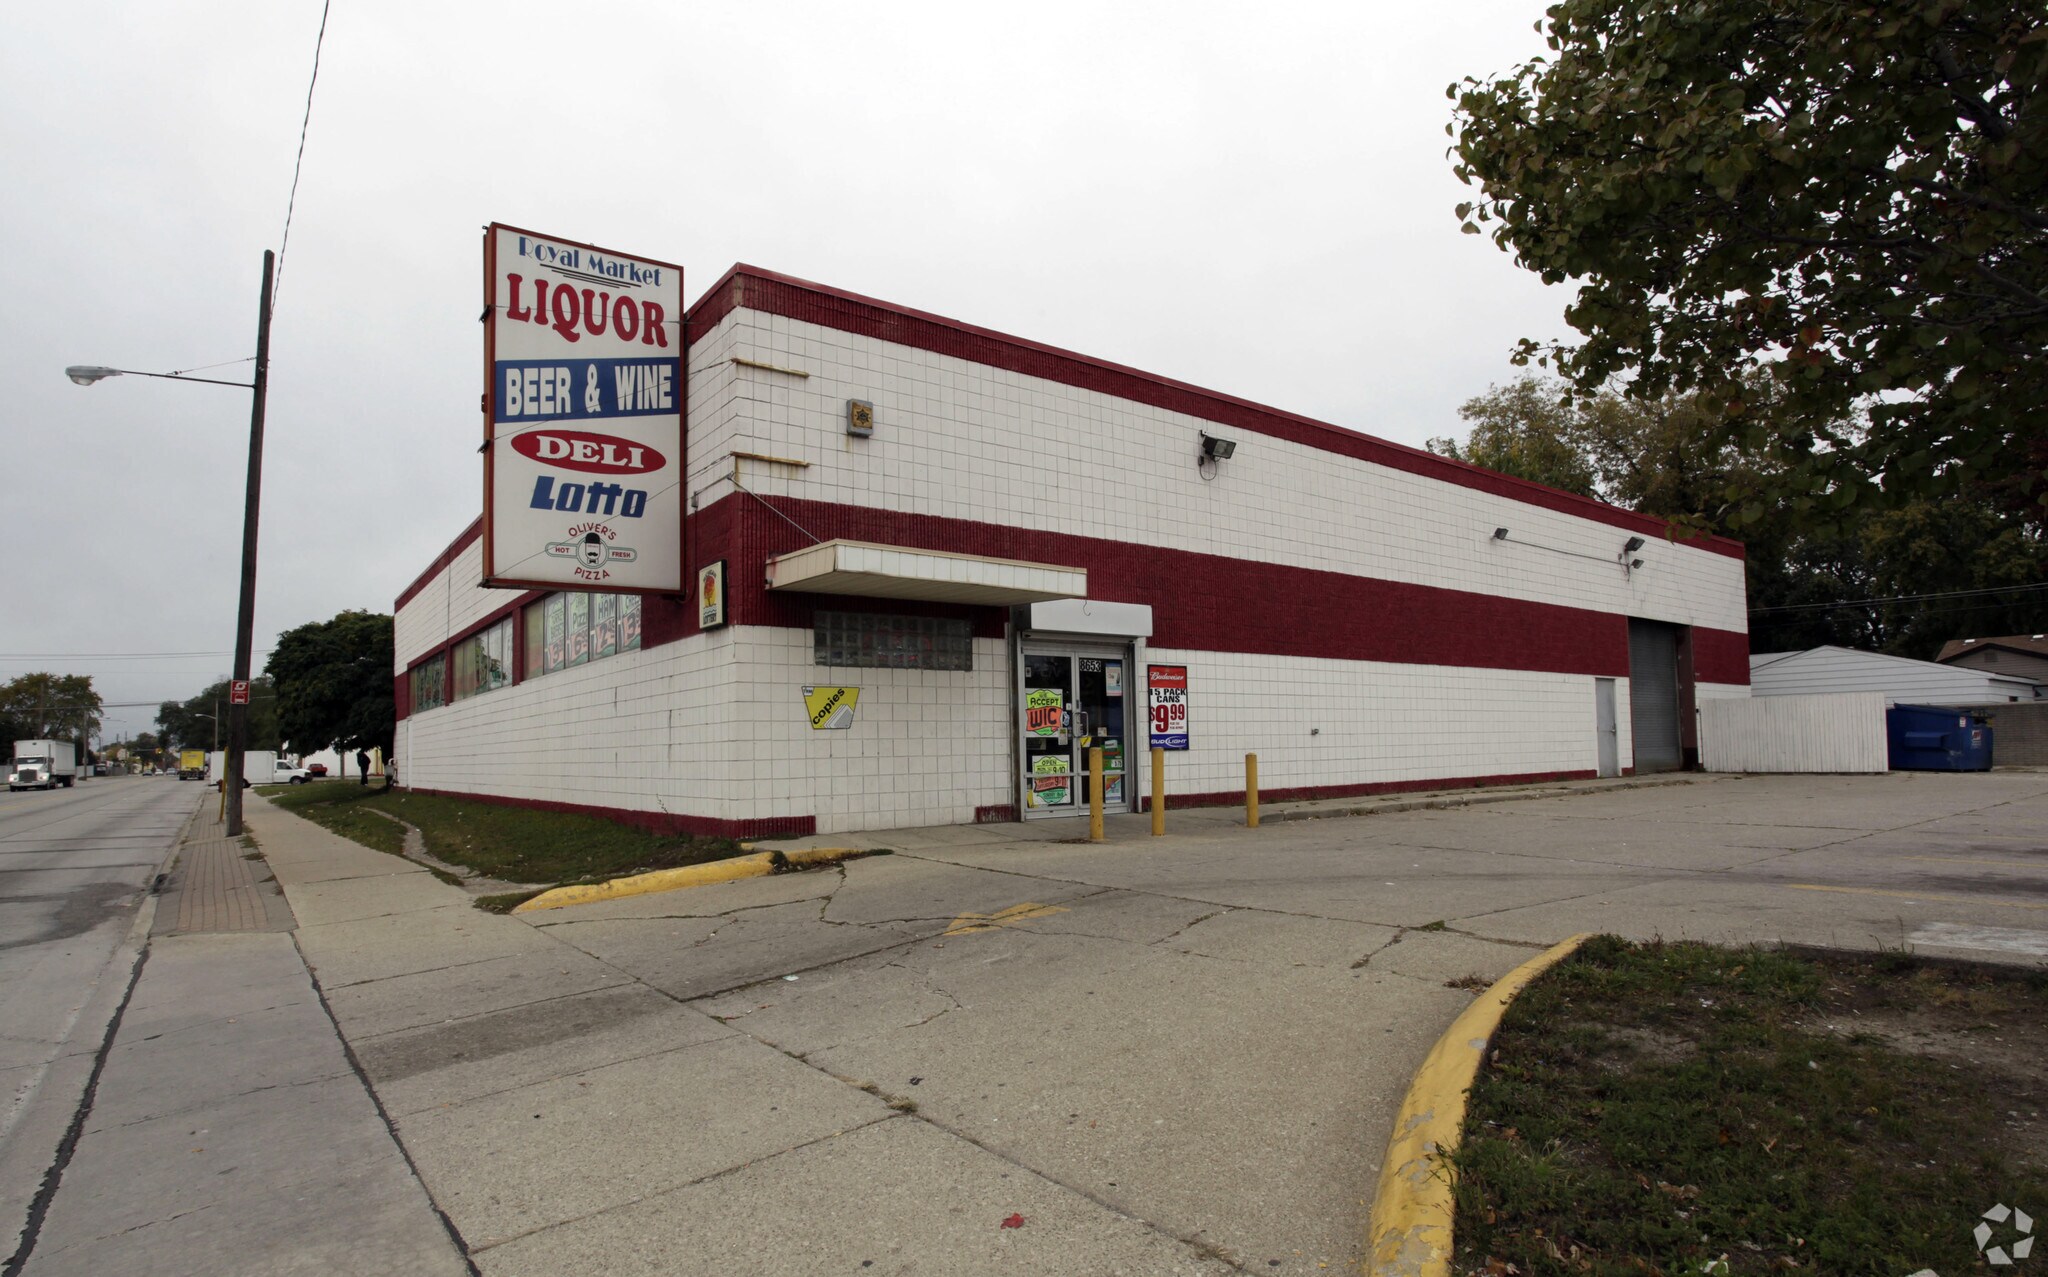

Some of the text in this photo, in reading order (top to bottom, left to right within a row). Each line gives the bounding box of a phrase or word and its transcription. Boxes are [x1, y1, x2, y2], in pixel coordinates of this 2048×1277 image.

[519, 236, 662, 287] Royal Market
[507, 273, 668, 348] LIQUOR
[506, 363, 672, 416] BEER & WINE
[536, 435, 645, 469] DELI
[529, 475, 648, 519] Lotto
[568, 522, 617, 541] OLIVER'S
[555, 546, 631, 559] HOT FRESH
[574, 567, 610, 581] PIZZA
[1080, 660, 1101, 672] 8653
[1150, 671, 1185, 680] Budweiser
[1030, 697, 1059, 706] ACCEPT
[1150, 688, 1186, 696] 15 PACK
[1156, 695, 1180, 703] CANS
[812, 688, 845, 725] copies
[1030, 708, 1057, 728] WIC
